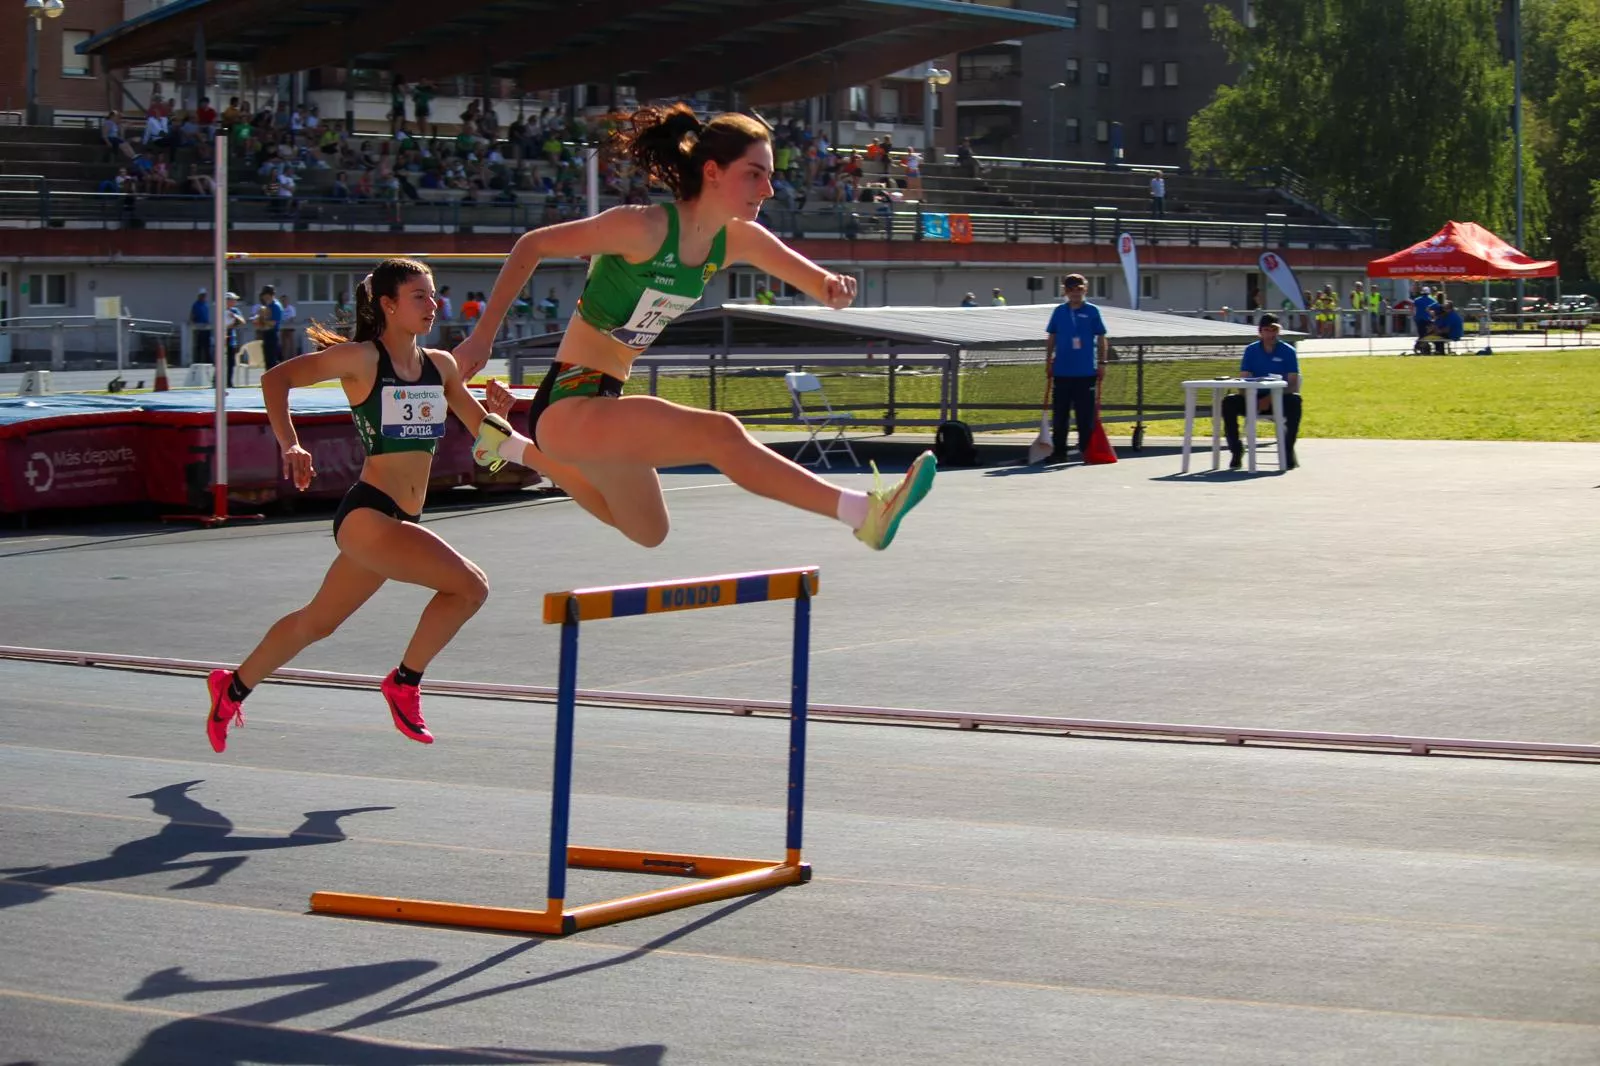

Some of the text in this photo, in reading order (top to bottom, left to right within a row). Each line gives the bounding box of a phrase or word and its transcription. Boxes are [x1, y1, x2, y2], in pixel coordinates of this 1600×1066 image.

[635, 311, 662, 329] 27
[24, 378, 34, 392] 2
[402, 403, 414, 421] 3
[53, 448, 82, 468] Más
[662, 584, 721, 609] MONDO
